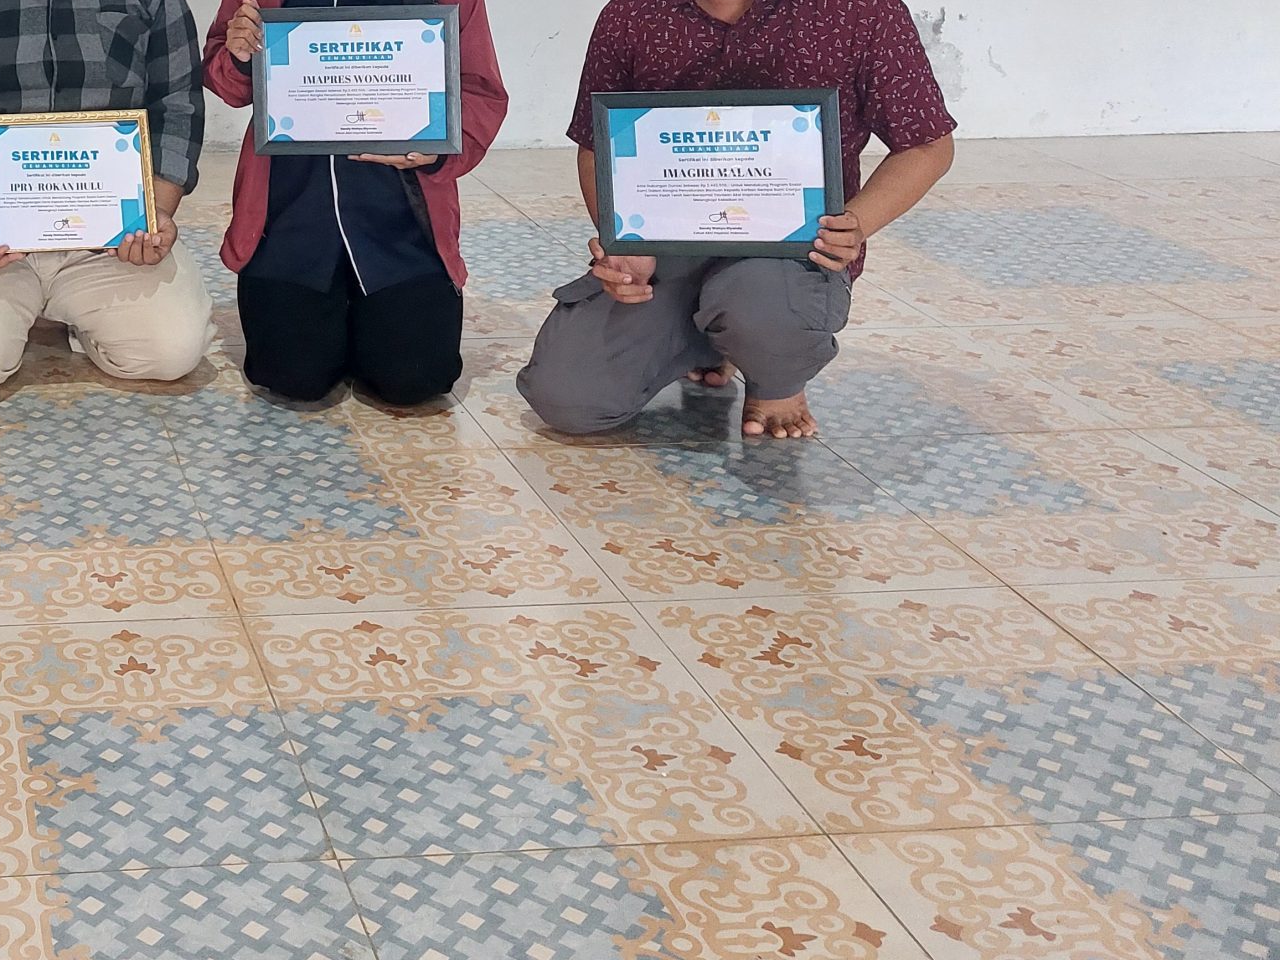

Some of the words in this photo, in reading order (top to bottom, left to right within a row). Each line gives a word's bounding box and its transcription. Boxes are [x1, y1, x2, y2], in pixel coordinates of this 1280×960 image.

[309, 41, 404, 53] SERTIFIKAT
[303, 74, 351, 84] IMAPRES
[353, 73, 412, 83] WONOGIRI
[659, 129, 772, 144] SERTIFIKAT
[11, 150, 99, 161] SERTIFIKAT
[663, 168, 715, 178] IMAGIRI
[717, 167, 772, 178] MALANG
[10, 183, 33, 191] IPRY
[38, 182, 74, 191] ROKAN
[76, 182, 103, 191] HULU
